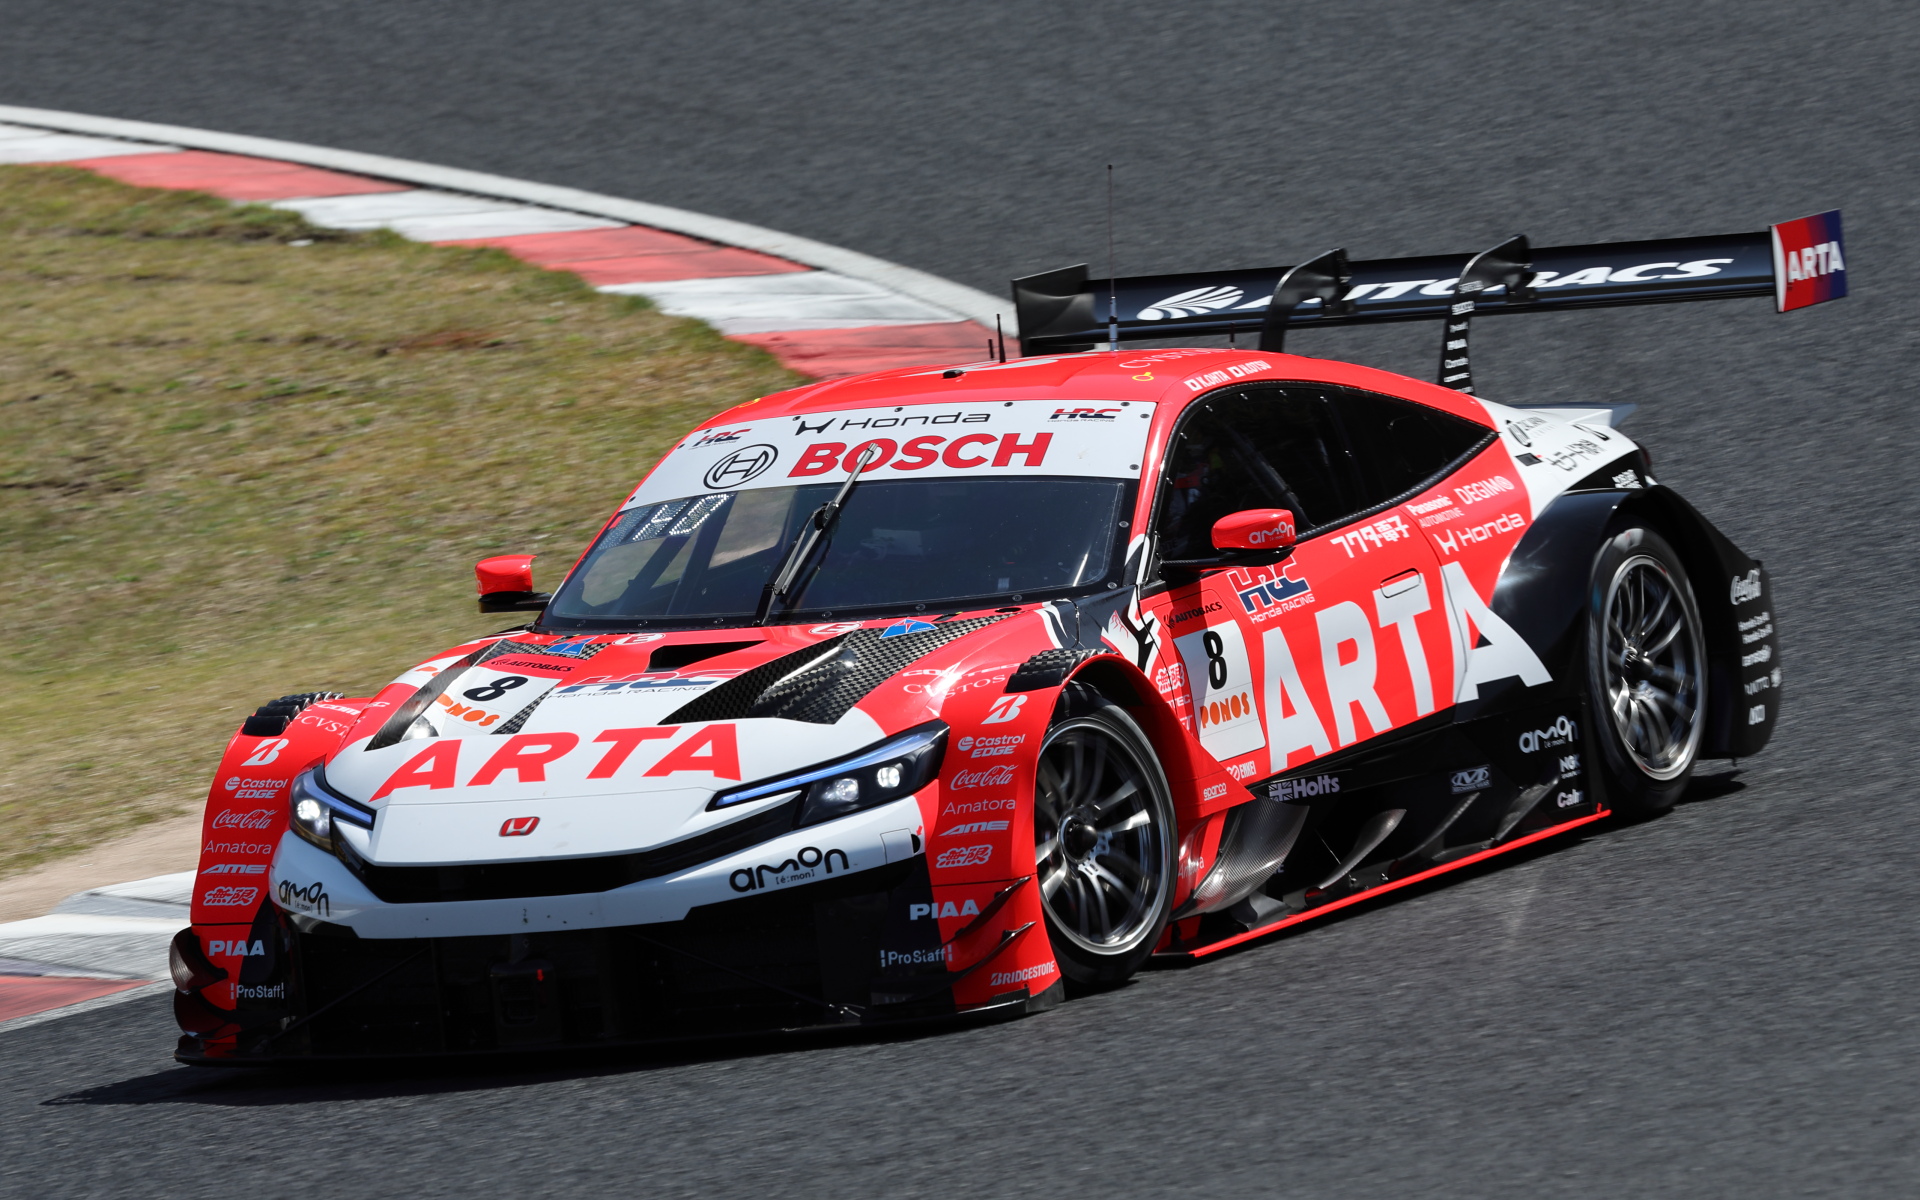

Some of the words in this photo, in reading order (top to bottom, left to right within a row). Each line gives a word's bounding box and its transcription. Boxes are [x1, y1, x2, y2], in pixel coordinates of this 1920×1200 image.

[1788, 241, 1845, 283] ARTA
[840, 411, 991, 431] Honda
[1049, 408, 1123, 419] HRC
[786, 432, 1054, 478] BOSCH
[1405, 495, 1453, 516] Panasonic
[1418, 507, 1466, 529] AUTOMOTIVE
[1249, 521, 1295, 544] amon
[1457, 512, 1526, 547] Honda
[1175, 601, 1223, 624] AUTOBACS
[1250, 605, 1283, 625] Honda
[1283, 593, 1316, 613] RACING
[507, 660, 576, 673] AUTOBACS
[1203, 630, 1228, 689] 8
[1262, 561, 1553, 774] ARTA
[463, 675, 529, 702] 8
[548, 690, 621, 700] Honda
[627, 685, 709, 695] RACING
[1201, 692, 1251, 728] PONOS
[975, 734, 1026, 748] Castrol
[1519, 715, 1579, 753] amon
[367, 722, 742, 803] ARTA
[970, 745, 1017, 758] EDGE
[241, 778, 288, 789] Castrol
[950, 764, 1019, 791] Coca-Cola
[1292, 775, 1340, 799] Holts
[234, 789, 279, 798] EDGE
[1203, 782, 1227, 800] sparco
[942, 799, 1016, 816] Amatora
[212, 809, 278, 829] Coca-Cola
[938, 820, 1010, 836] AME
[202, 840, 272, 854] Amatora
[200, 864, 267, 874] AME
[729, 846, 849, 892] amon
[279, 880, 330, 917] amon
[909, 900, 981, 920] PIAA
[209, 940, 265, 956] PIAA
[990, 961, 1056, 987] BRIDGESTONE
